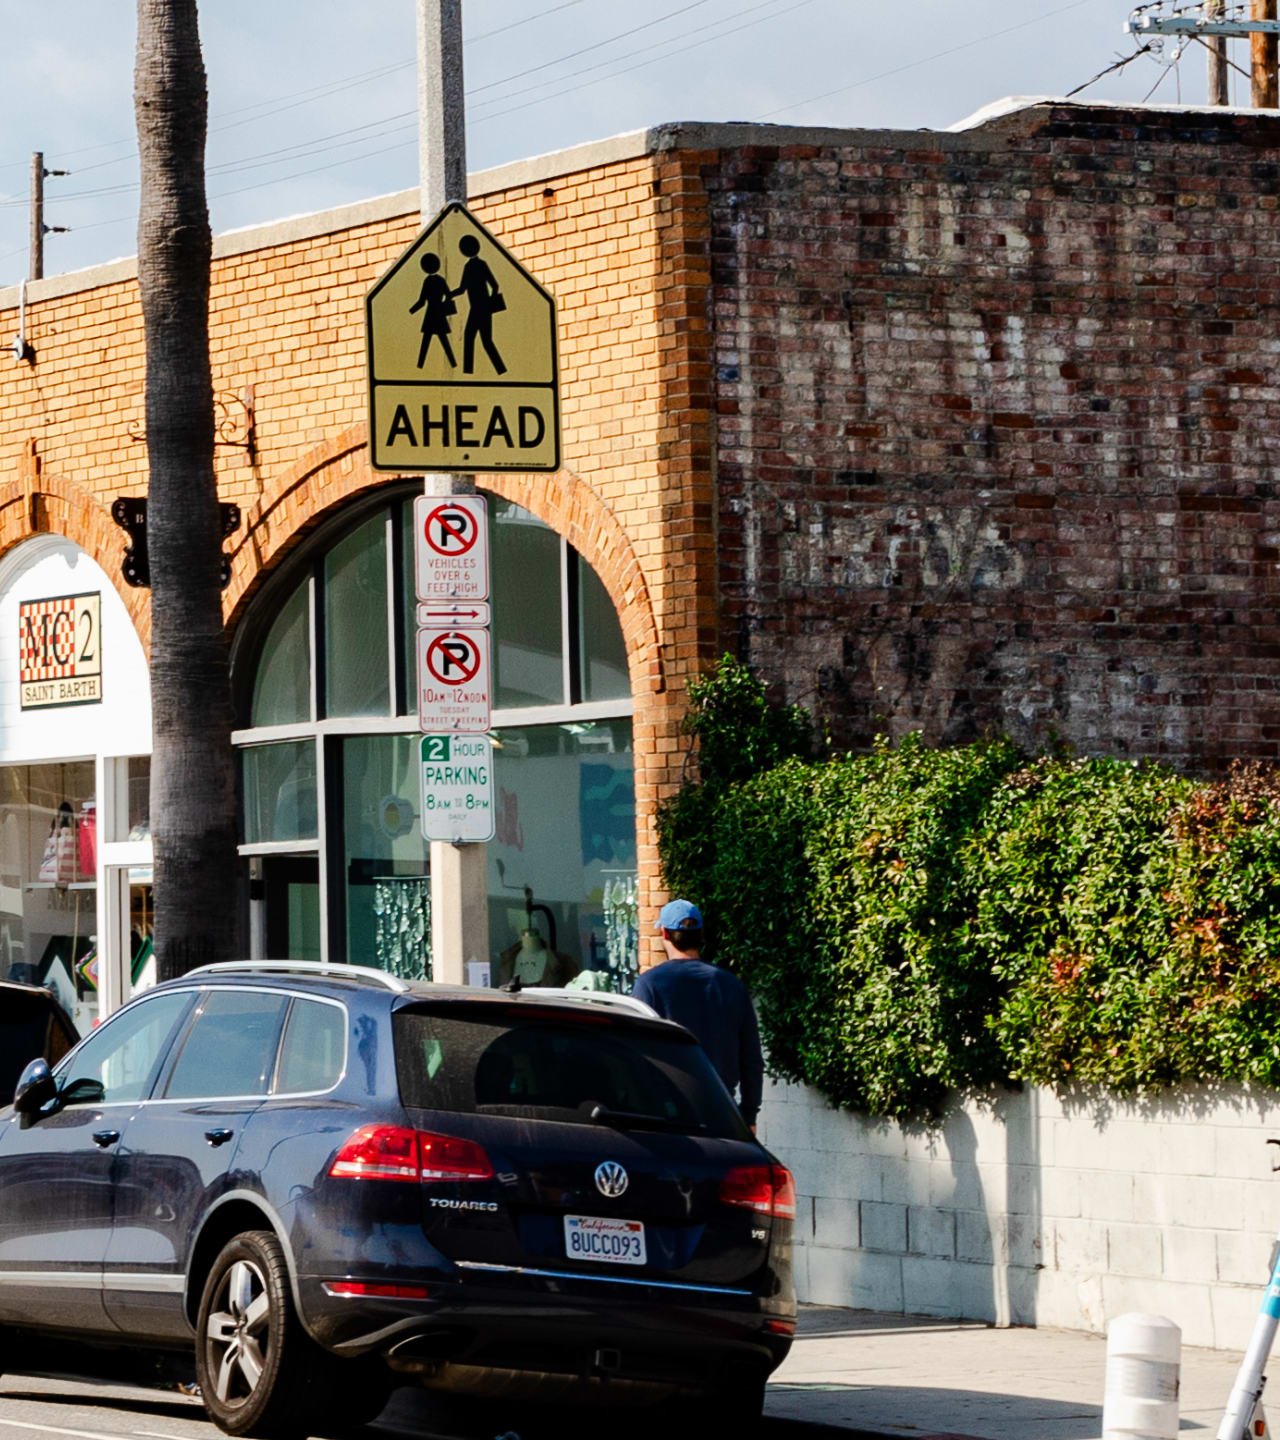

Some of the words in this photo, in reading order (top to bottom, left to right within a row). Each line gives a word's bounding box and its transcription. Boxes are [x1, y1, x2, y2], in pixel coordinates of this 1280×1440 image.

[386, 404, 545, 449] AHEAD
[428, 558, 477, 569] VEHICLES
[434, 571, 460, 581] OVER
[464, 570, 471, 581] 6
[427, 583, 450, 593] FEET
[454, 583, 478, 593] HIGH
[25, 684, 55, 702] SAINT
[59, 680, 97, 699] BARTH
[423, 688, 445, 703] 10AM
[453, 688, 487, 703] 12NOON
[428, 738, 444, 760] 2
[453, 743, 485, 756] HOUR
[426, 766, 487, 785] PARKING
[426, 793, 451, 810] 8AM
[466, 793, 489, 810] 8PM
[429, 1198, 499, 1211] TOUAREG
[580, 1219, 626, 1233] California
[751, 1229, 766, 1240] V6
[571, 1231, 641, 1257] 8UCC093
